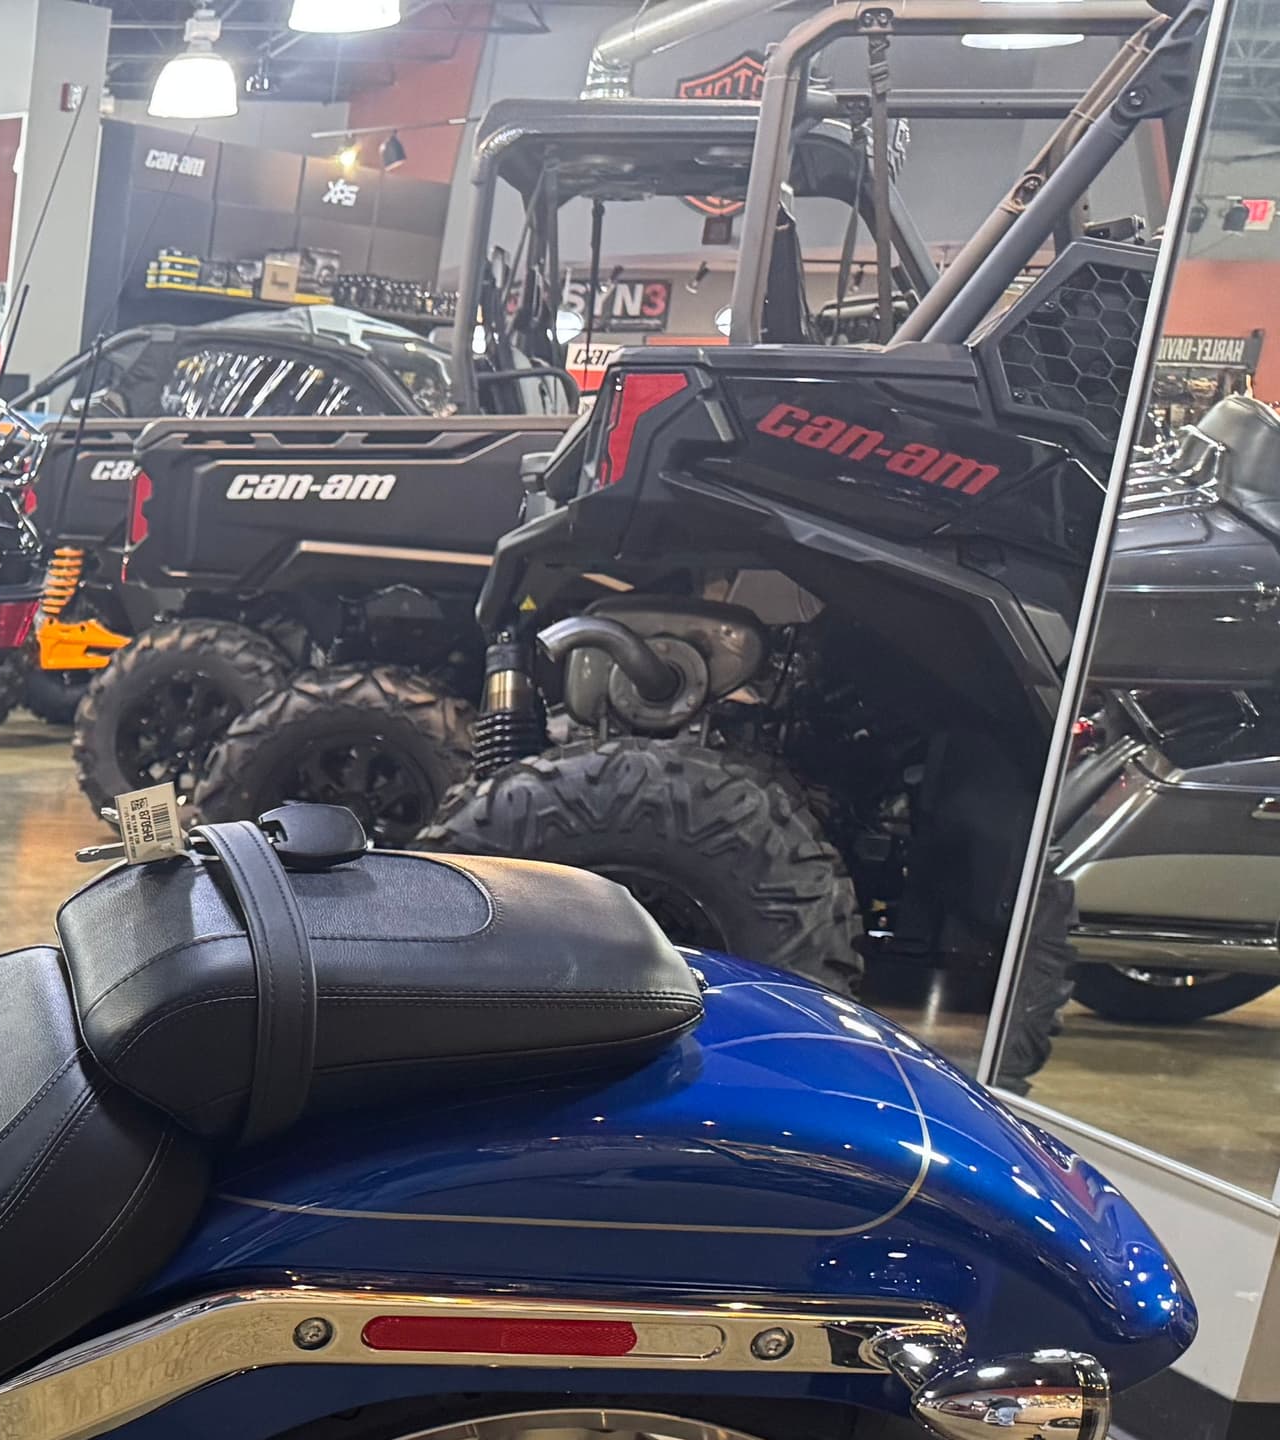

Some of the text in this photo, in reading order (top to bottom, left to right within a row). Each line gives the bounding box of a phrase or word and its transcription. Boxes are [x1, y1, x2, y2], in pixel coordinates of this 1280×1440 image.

[145, 148, 205, 177] can-am
[566, 283, 667, 317] SYN3
[756, 403, 1000, 496] can-am
[226, 474, 397, 501] can-am
